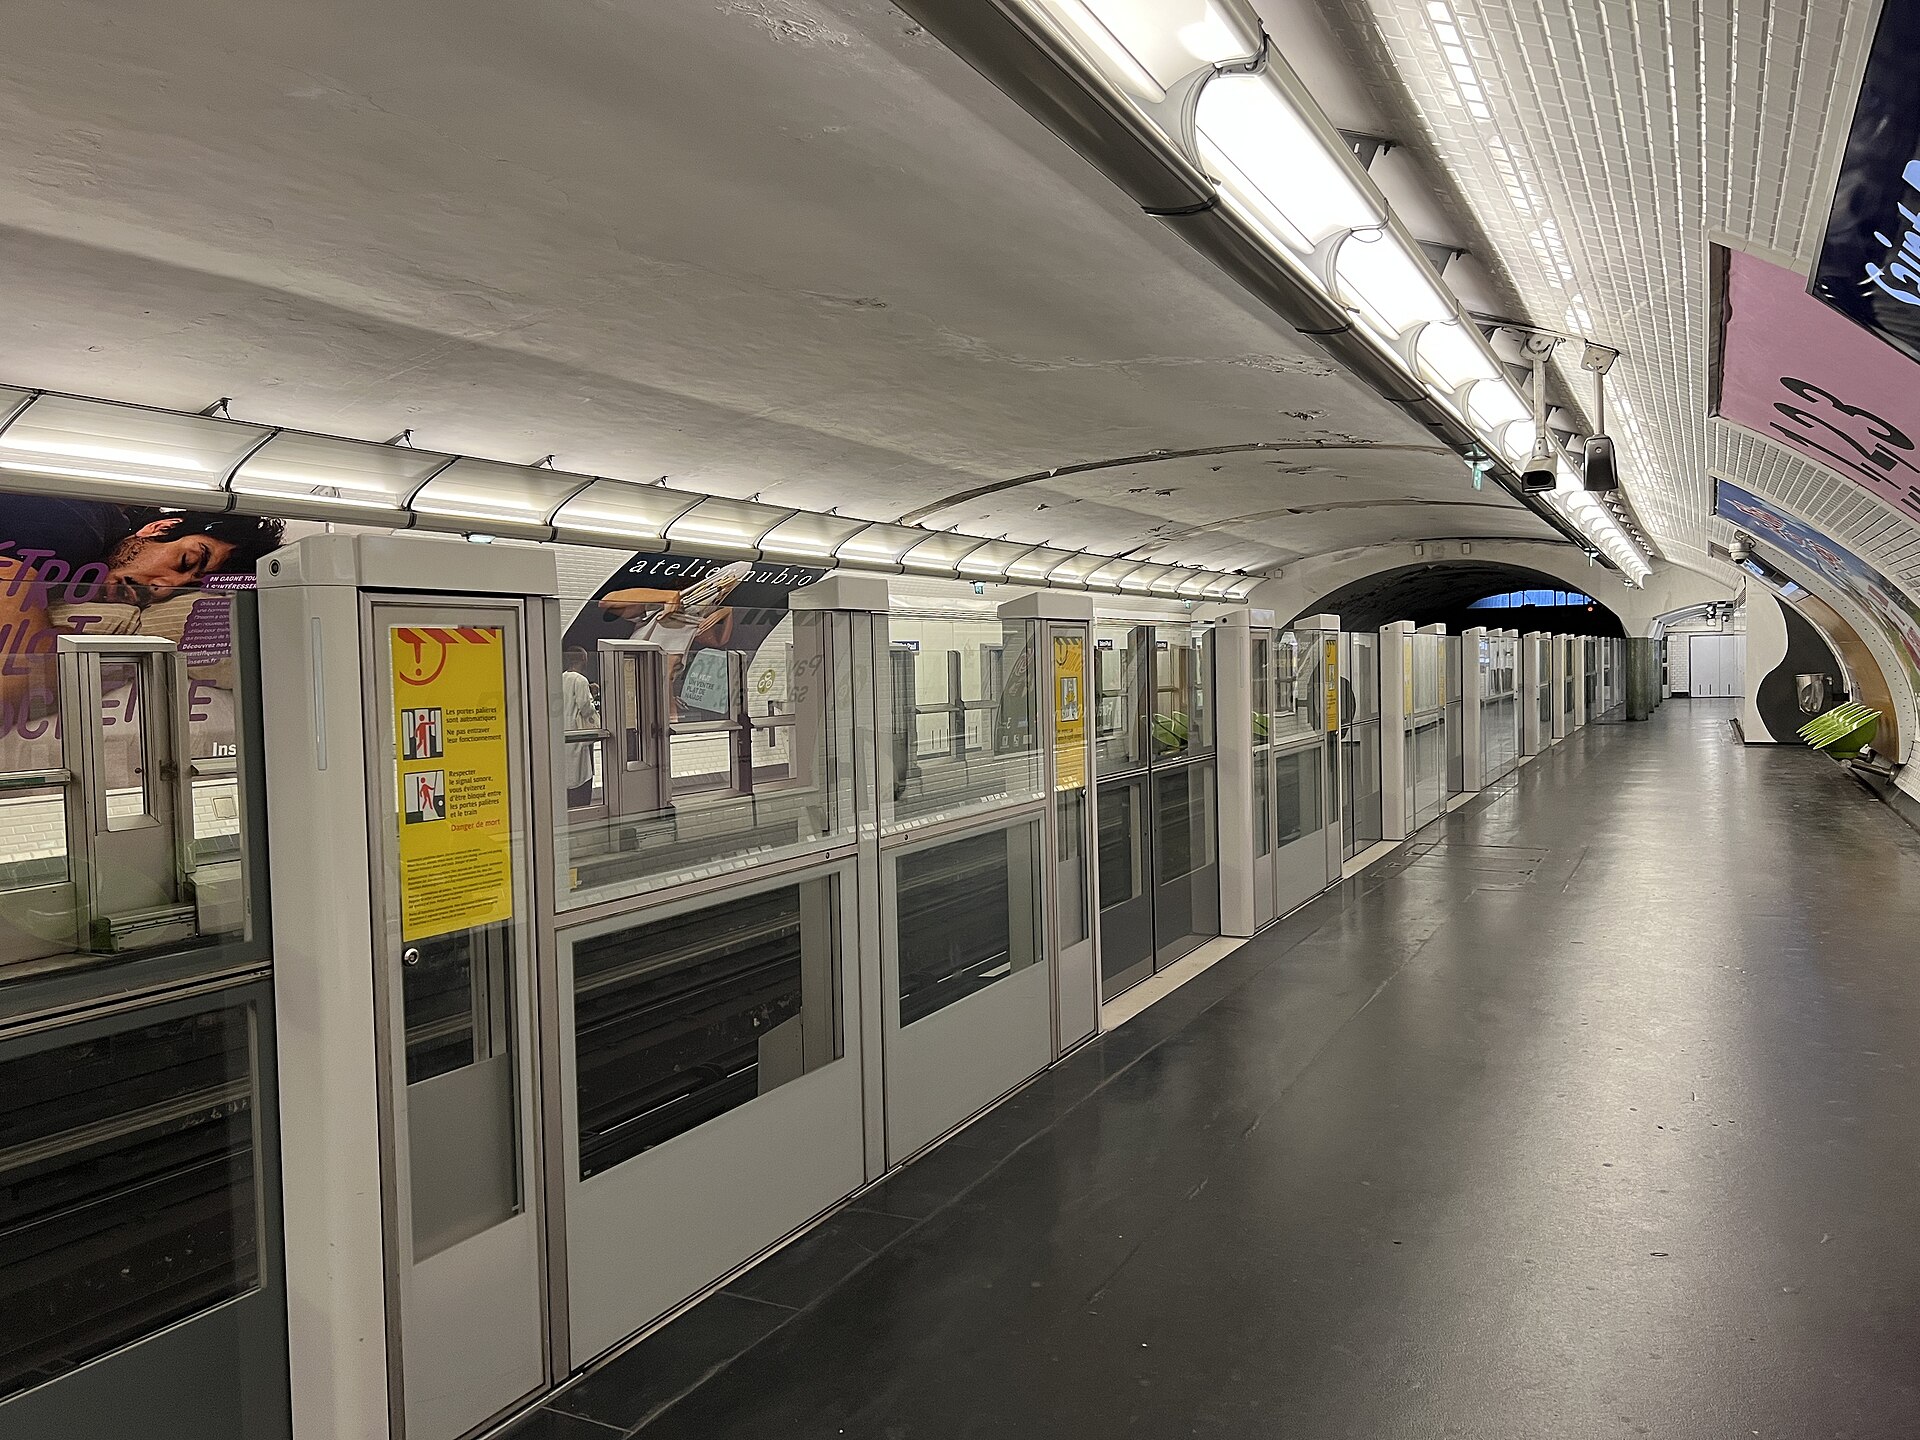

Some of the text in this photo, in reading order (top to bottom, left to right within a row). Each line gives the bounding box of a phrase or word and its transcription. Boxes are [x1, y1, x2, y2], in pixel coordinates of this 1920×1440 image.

[629, 558, 812, 586] atelie nubio
[182, 642, 216, 650] Découvrez
[475, 706, 497, 714] palières
[459, 734, 502, 742] fonctionnement
[448, 769, 476, 777] Respecter
[455, 777, 473, 786] signal
[463, 784, 486, 792] éviterez
[449, 794, 466, 802] d'être
[467, 791, 487, 799] bloqué
[459, 801, 477, 810] portes
[478, 799, 500, 807] palières
[451, 823, 475, 831] Danger
